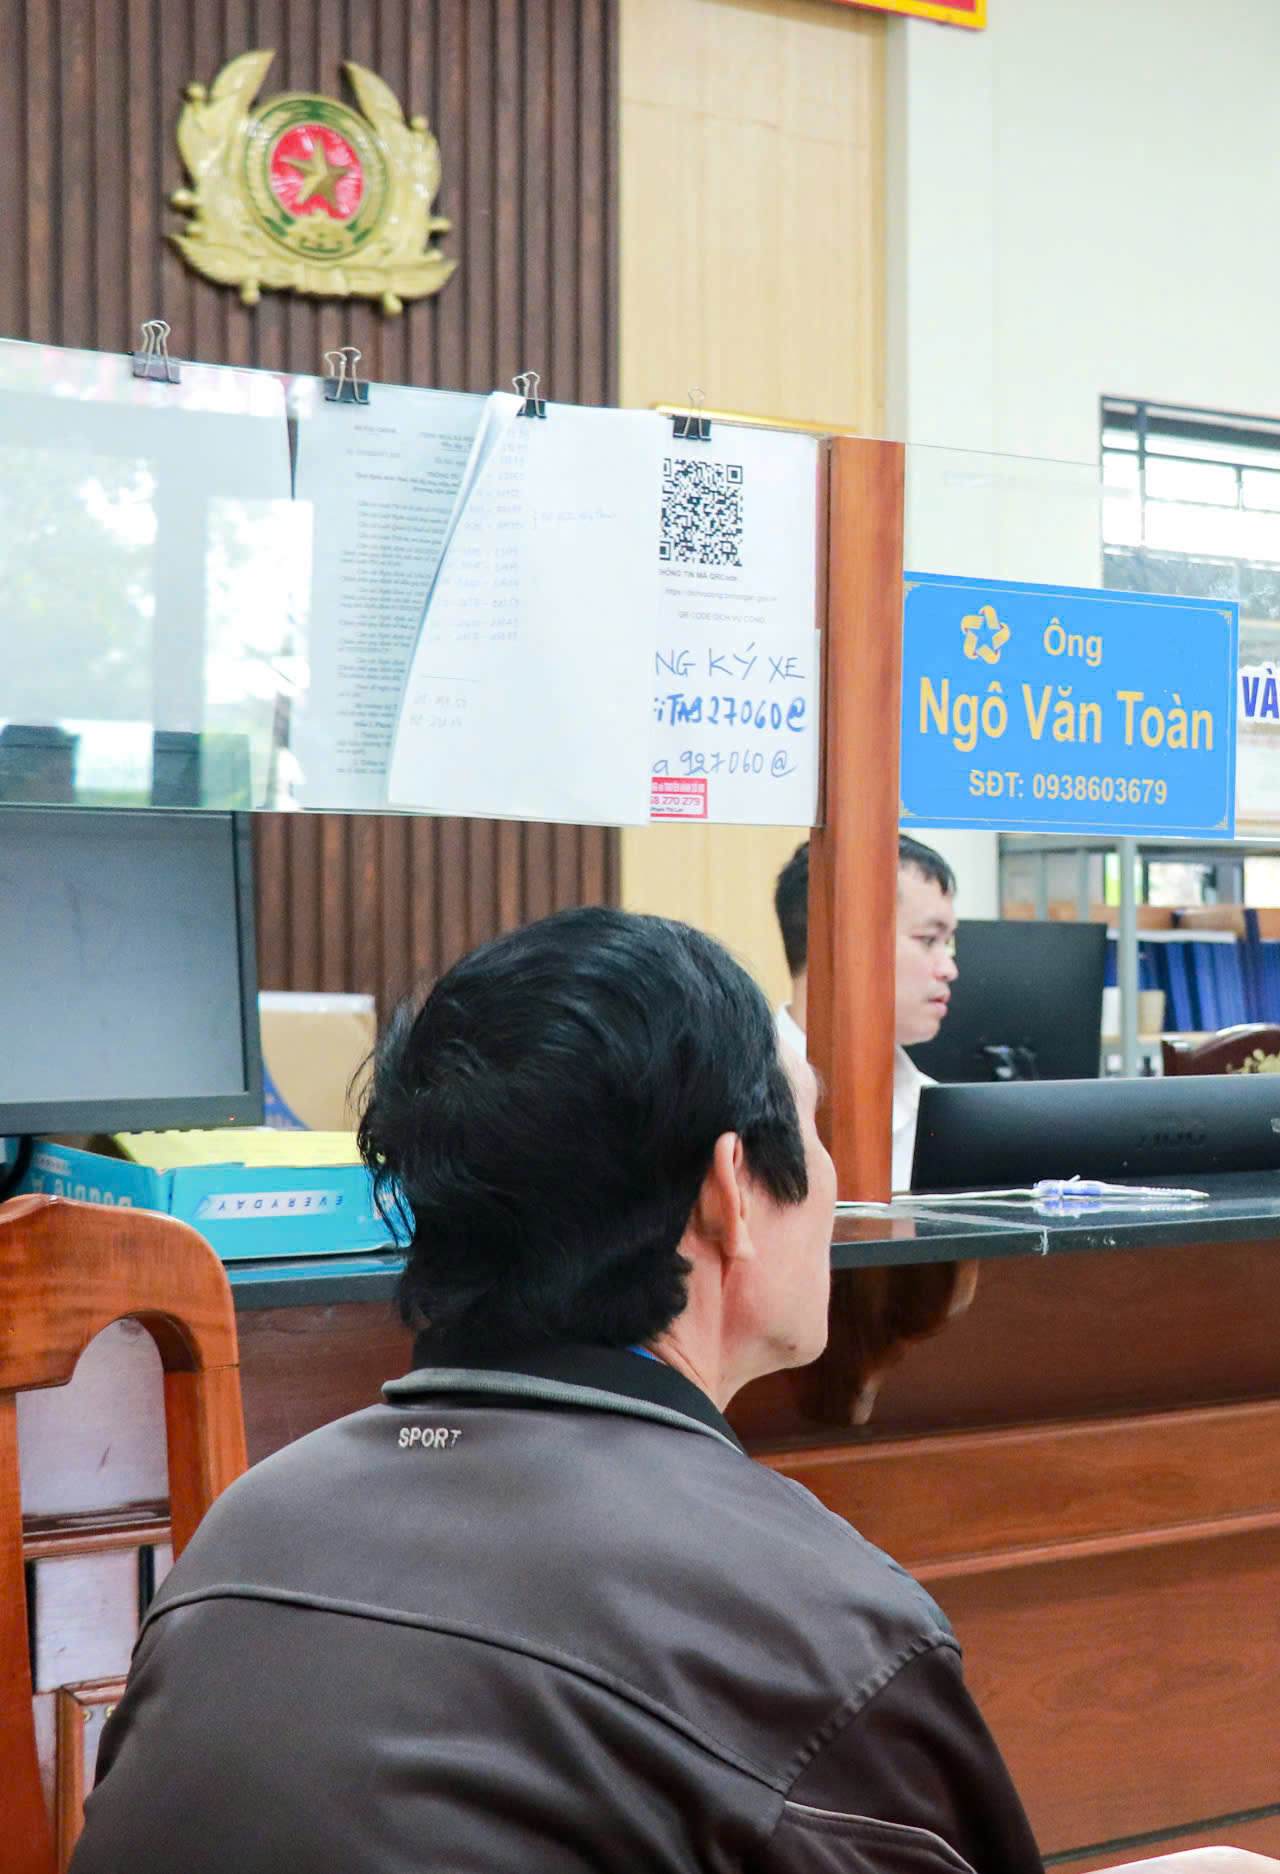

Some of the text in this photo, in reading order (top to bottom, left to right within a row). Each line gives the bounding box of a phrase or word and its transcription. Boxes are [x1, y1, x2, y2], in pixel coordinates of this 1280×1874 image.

[708, 641, 758, 681] KÝ
[767, 655, 806, 684] XE
[1042, 616, 1103, 667] Ông
[919, 676, 1214, 753] Ngô Văn Toàn
[1241, 667, 1280, 720] VÀ
[968, 769, 1168, 805] SĐT: 0938603679
[218, 1194, 344, 1212] EVERYDAY
[398, 1427, 462, 1448] SPORT
